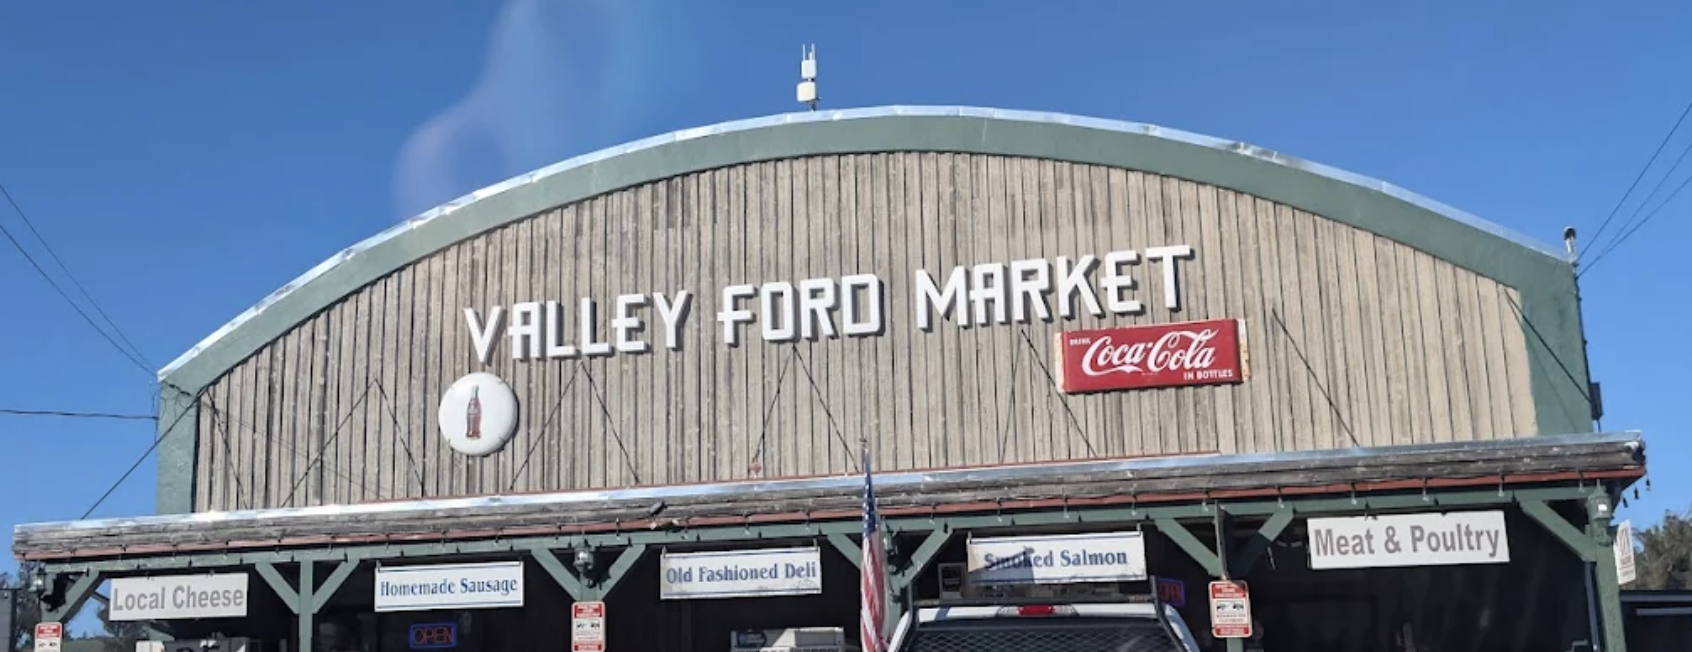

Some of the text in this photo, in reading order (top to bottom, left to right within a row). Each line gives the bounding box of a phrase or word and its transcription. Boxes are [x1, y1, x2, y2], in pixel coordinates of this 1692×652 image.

[464, 245, 1193, 363] VALLEY FORD MARKET
[1070, 337, 1091, 346] DRINK
[1183, 369, 1233, 380] IN BOTTLES
[1314, 523, 1500, 558] Meat & Poultry
[984, 549, 1128, 569] Smoked Salmon
[666, 561, 816, 584] Old Fashioned Deli
[380, 577, 517, 597] Homemade Sausage
[112, 585, 244, 611] Local Cheese
[413, 626, 453, 645] OPEN
